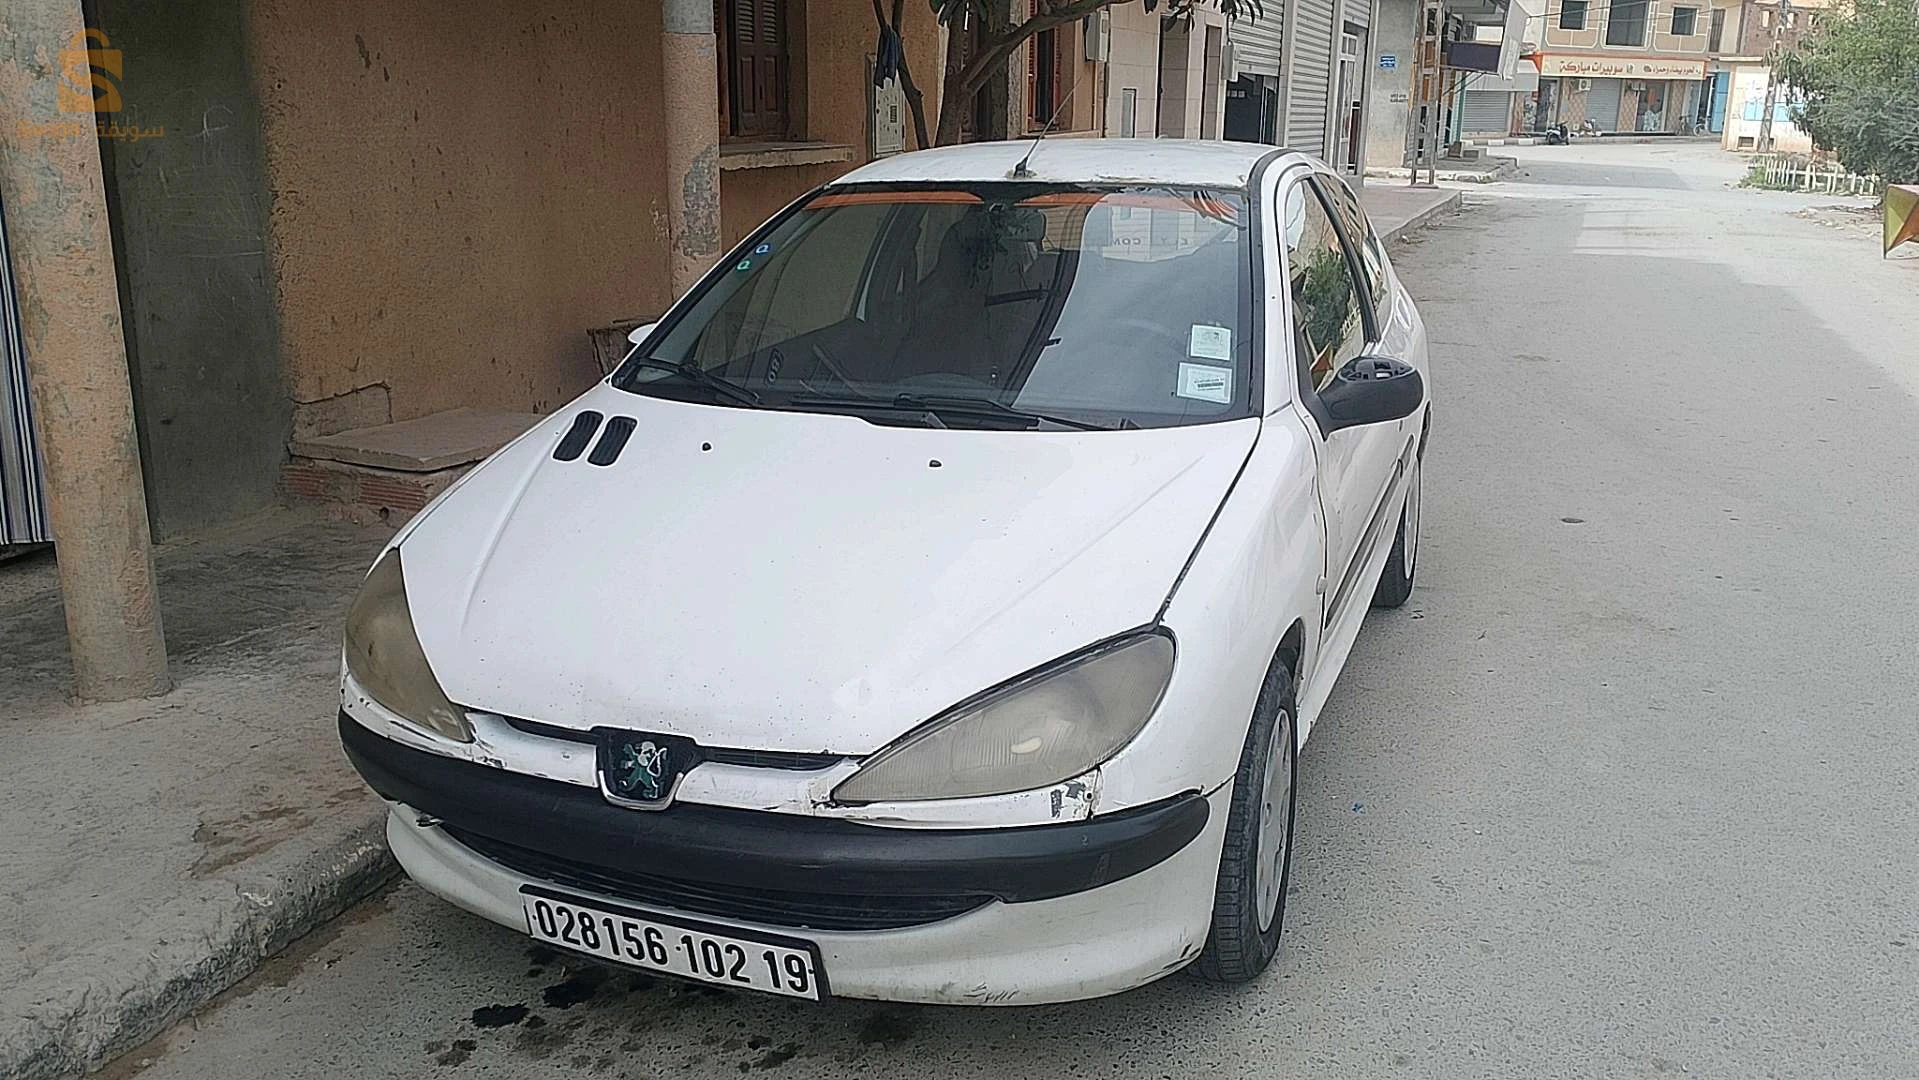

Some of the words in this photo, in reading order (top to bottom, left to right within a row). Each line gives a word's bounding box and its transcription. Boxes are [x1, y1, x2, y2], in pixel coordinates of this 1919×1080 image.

[1559, 60, 1591, 75] مباركة
[534, 899, 668, 966] 028156
[681, 935, 751, 983] 102
[762, 950, 809, 993] 19
